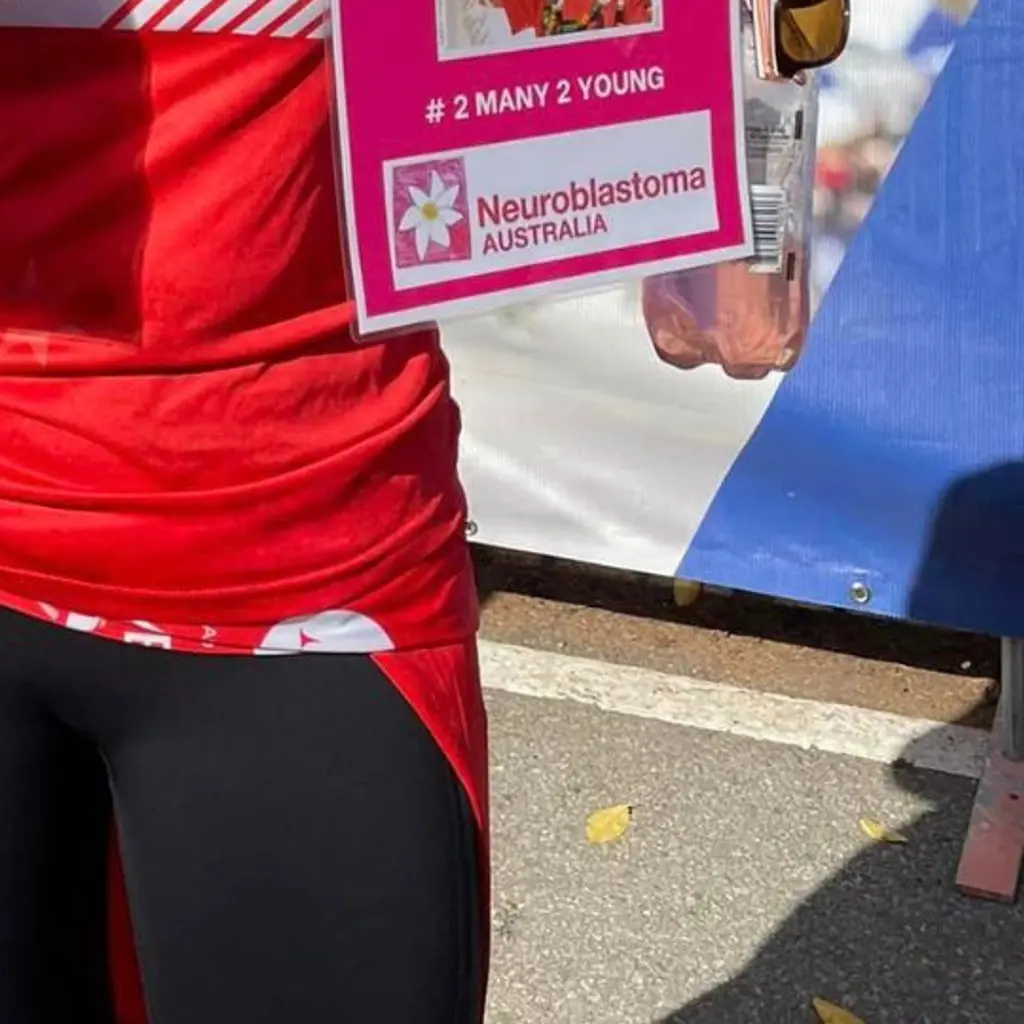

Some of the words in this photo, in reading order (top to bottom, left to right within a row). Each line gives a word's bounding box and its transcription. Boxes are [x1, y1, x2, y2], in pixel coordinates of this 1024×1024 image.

[453, 95, 470, 120] 2
[475, 82, 550, 117] MANY
[556, 79, 572, 104] 2
[578, 66, 665, 101] YOUNG
[476, 166, 707, 228] Neuroblastoma
[482, 213, 609, 255] AUSTRALIA
